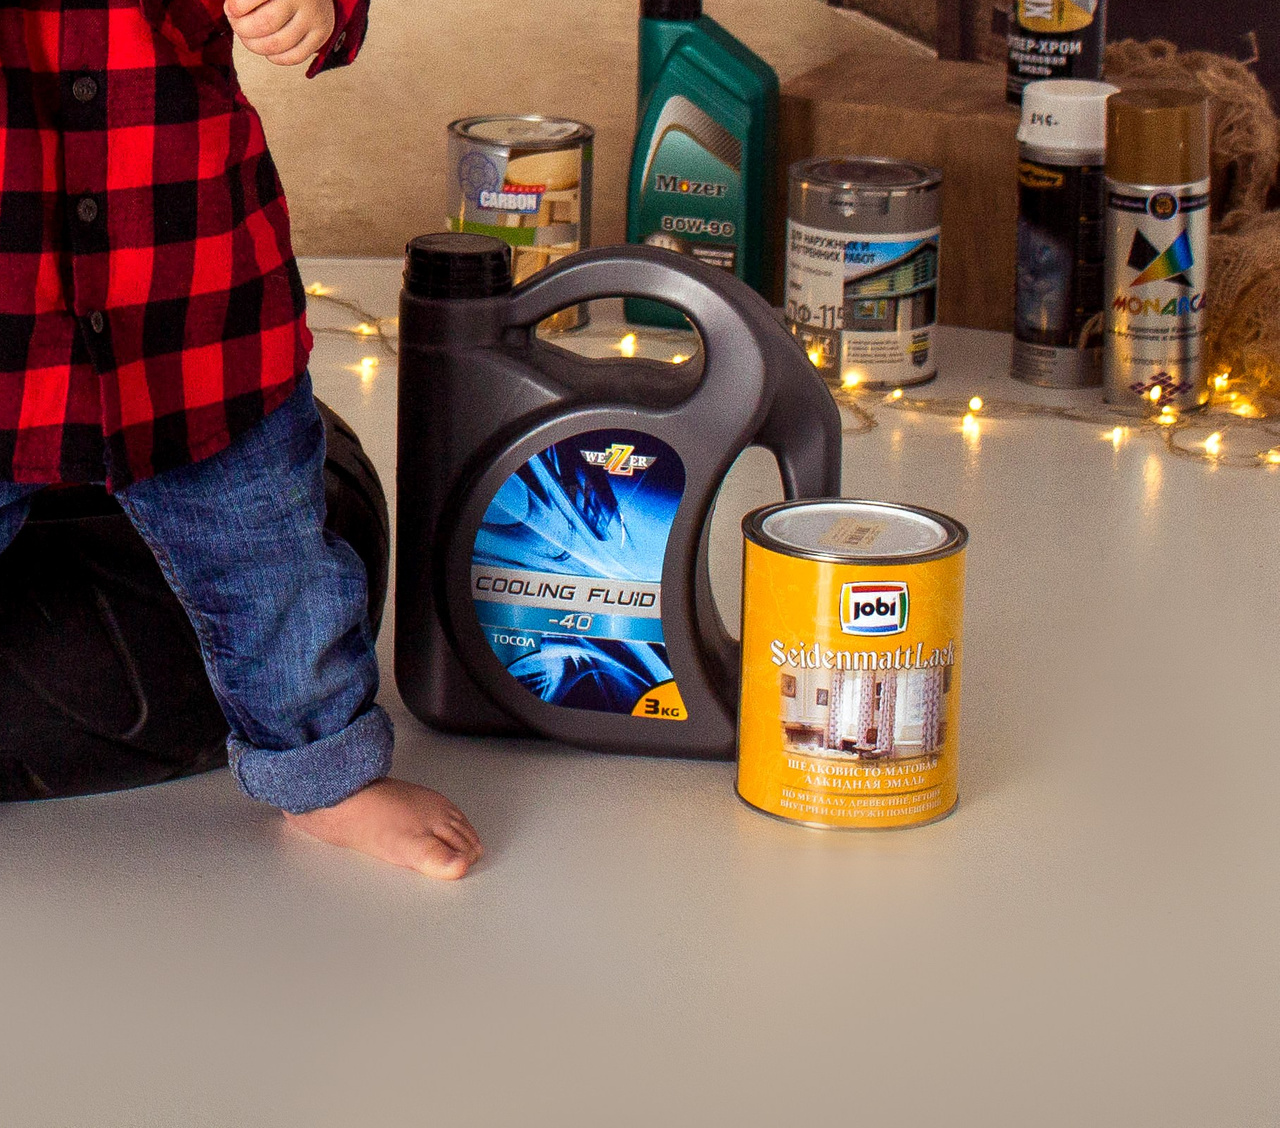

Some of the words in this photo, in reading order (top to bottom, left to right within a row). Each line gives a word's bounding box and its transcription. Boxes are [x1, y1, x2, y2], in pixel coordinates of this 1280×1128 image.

[655, 174, 729, 197] Mozer
[480, 191, 538, 210] CARBON
[476, 575, 577, 601] COOLING
[587, 588, 657, 608] FLUID
[853, 596, 897, 620] jobi
[548, 613, 593, 631] -40
[804, 775, 881, 790] АЛКИДНАЯ
[884, 775, 926, 789] ЭМАЛЬ
